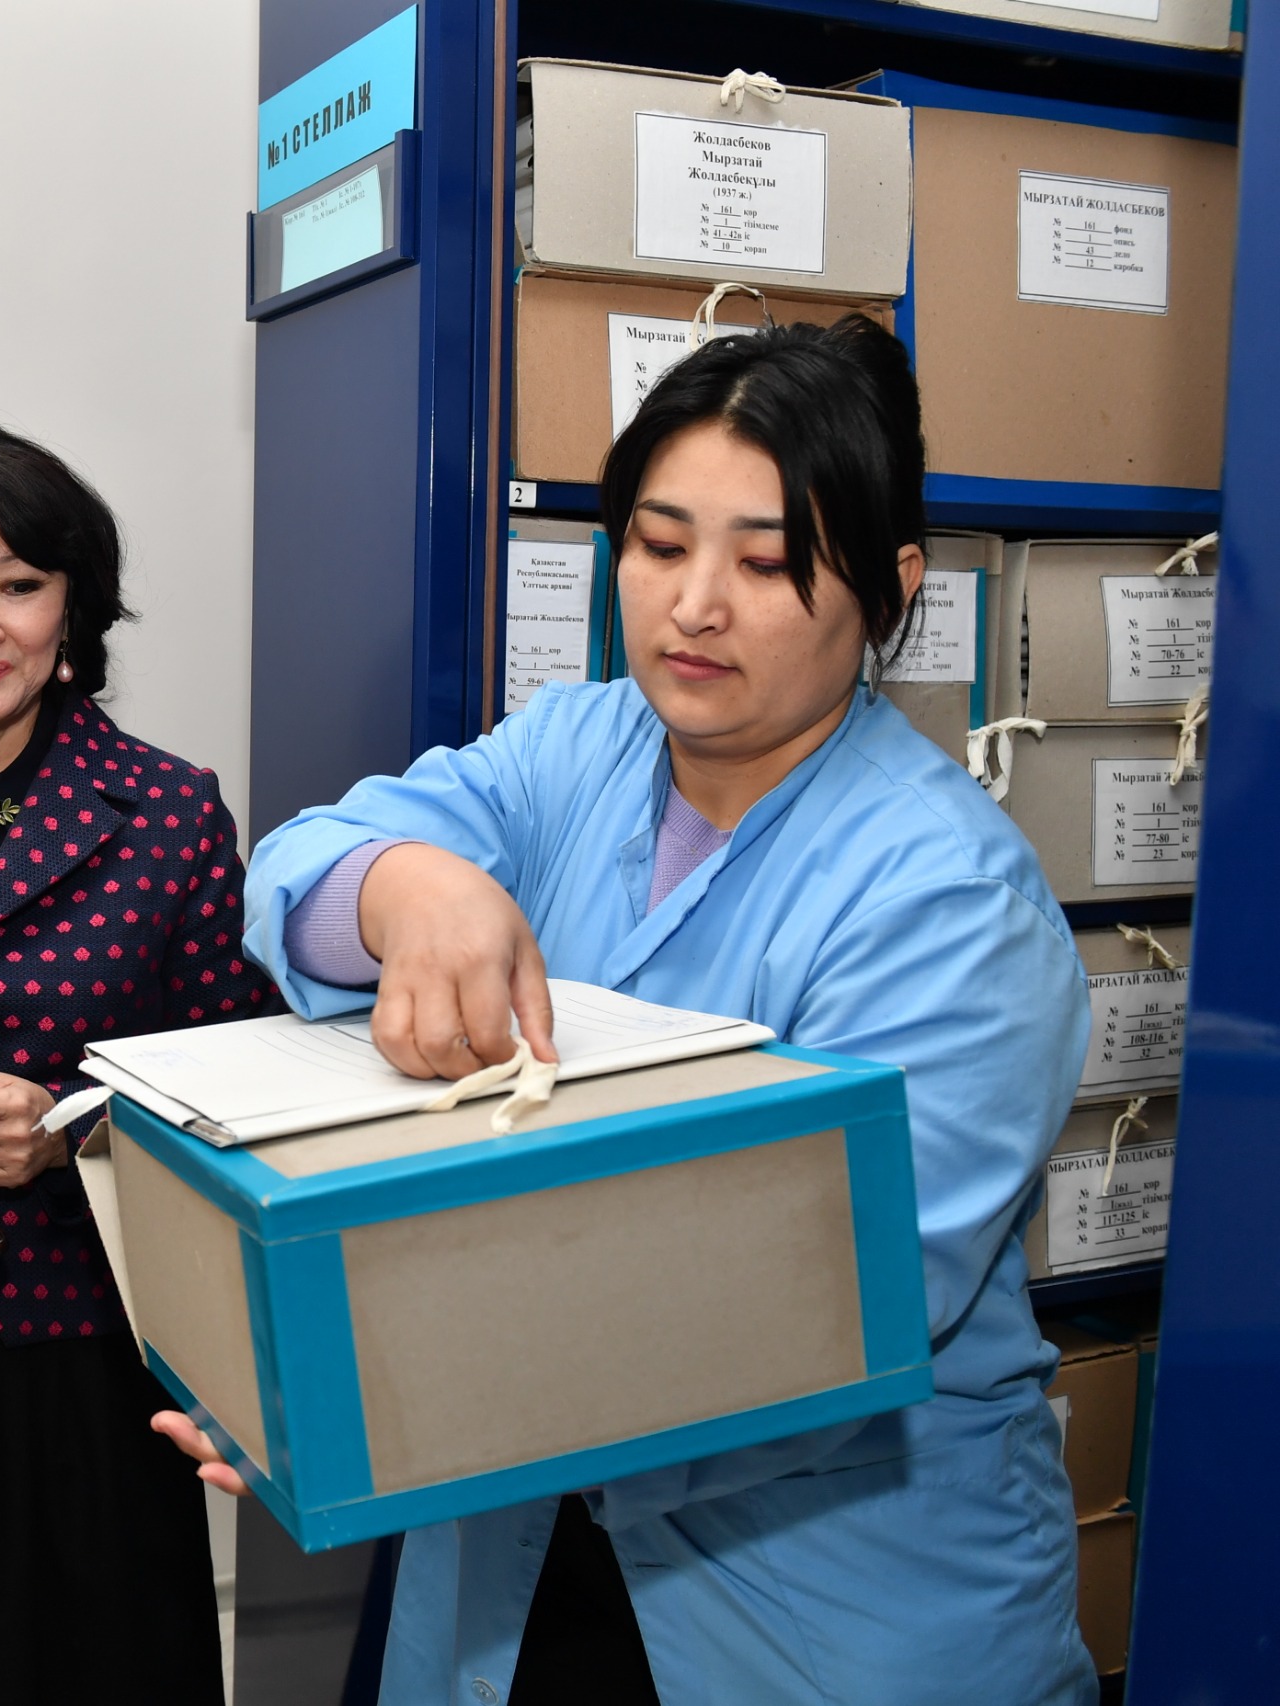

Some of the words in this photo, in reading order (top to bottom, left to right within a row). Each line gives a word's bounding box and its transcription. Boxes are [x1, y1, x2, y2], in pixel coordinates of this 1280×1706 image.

[293, 80, 371, 154] СТЕЛЛАЖ
[693, 131, 771, 151] Жолдасбеков
[702, 150, 763, 168] Мырзатай
[688, 166, 776, 188] Жолдасбекұлы
[713, 188, 736, 198] (1937
[701, 203, 709, 212] №
[720, 205, 733, 214] 161
[1023, 191, 1083, 208] МЫРЗАТАЙ
[1086, 198, 1165, 217] ЖОЛДАСБЕКОВ
[700, 215, 709, 224] №
[700, 228, 709, 236] №
[1053, 217, 1061, 226] №
[1084, 221, 1096, 230] 161
[1113, 225, 1133, 235] фонд
[1053, 230, 1061, 239] №
[699, 240, 709, 249] №
[722, 242, 730, 250] 10
[1052, 243, 1061, 251] №
[1085, 247, 1094, 255] 43
[1114, 251, 1130, 259] дело
[1052, 255, 1061, 264] №
[1086, 259, 1094, 267] 12
[626, 326, 686, 344] Мырзатай
[634, 362, 647, 373] №
[635, 379, 648, 391] №
[514, 487, 523, 503] 2
[531, 558, 566, 567] Қазақстан
[516, 569, 579, 579] Республикасының
[1121, 588, 1170, 601] Мырзатай
[540, 614, 584, 623] Жолдасбеков
[1128, 619, 1139, 629] №
[1166, 618, 1180, 629] 161
[1129, 634, 1140, 645] №
[1173, 634, 1176, 644] 1
[510, 645, 518, 653] №
[1131, 650, 1141, 661] №
[1161, 649, 1185, 660] 70-76
[509, 661, 517, 669] №
[1129, 666, 1140, 677] №
[1171, 665, 1180, 675] 22
[508, 677, 517, 685] №
[507, 693, 516, 701] №
[1112, 772, 1162, 785] Мырзатай
[1114, 803, 1126, 813] №
[1152, 802, 1166, 812] 161
[1114, 818, 1125, 829] №
[1157, 818, 1160, 828] 1
[1114, 834, 1125, 845] №
[1146, 833, 1170, 844] 77-80
[1114, 850, 1125, 861] №
[1153, 849, 1164, 860] 23
[1089, 973, 1140, 989] ЫРЗАТАЙ
[1108, 1006, 1119, 1017] №
[1145, 1003, 1159, 1013] 161
[1105, 1022, 1116, 1033] №
[1103, 1037, 1115, 1048] №
[1130, 1032, 1164, 1044] 108-116
[1101, 1052, 1113, 1063] №
[1140, 1048, 1151, 1059] 32
[1048, 1155, 1108, 1175] МЫРЗАТАЙ
[1079, 1189, 1089, 1200] №
[1114, 1183, 1128, 1193] 161
[1077, 1204, 1087, 1215] №
[1077, 1219, 1087, 1230] №
[1103, 1211, 1135, 1226] 117-125
[1077, 1234, 1088, 1245] №
[1115, 1228, 1126, 1239] 33
